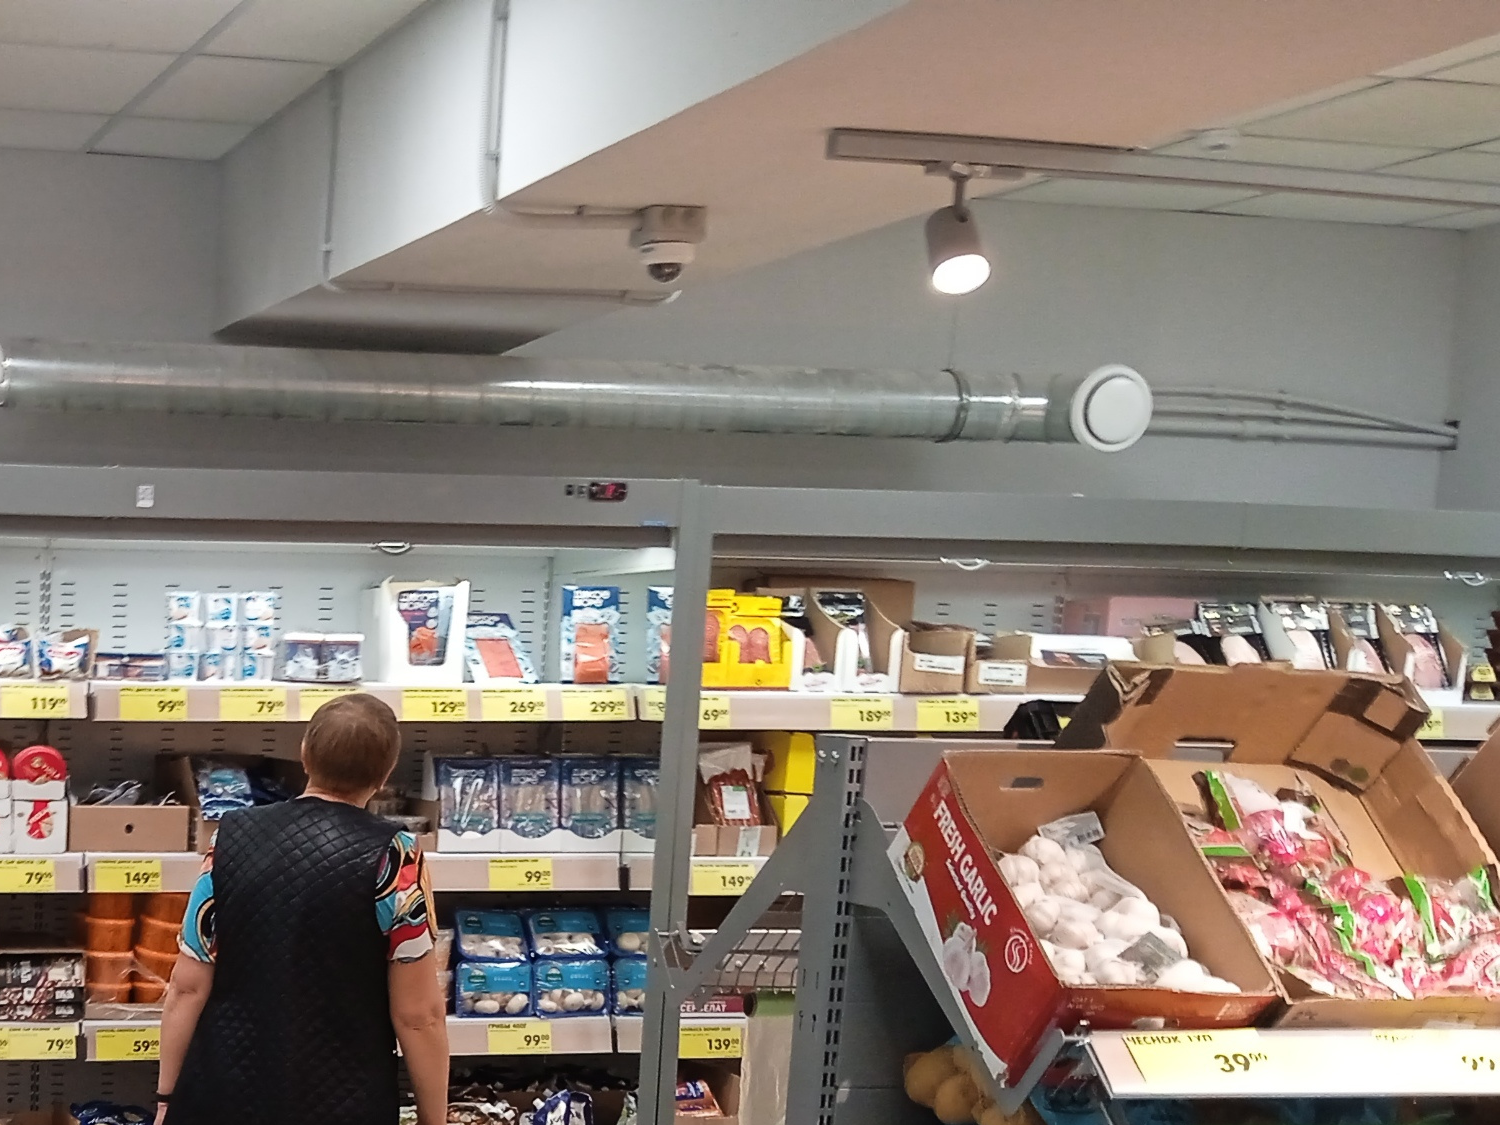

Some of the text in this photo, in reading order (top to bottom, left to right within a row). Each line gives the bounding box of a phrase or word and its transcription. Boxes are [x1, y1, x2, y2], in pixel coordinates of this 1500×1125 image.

[933, 799, 998, 926] FRESH GARLIC
[680, 1003, 728, 1013] СЕРЕЛАТ
[1214, 1053, 1250, 1073] 39
